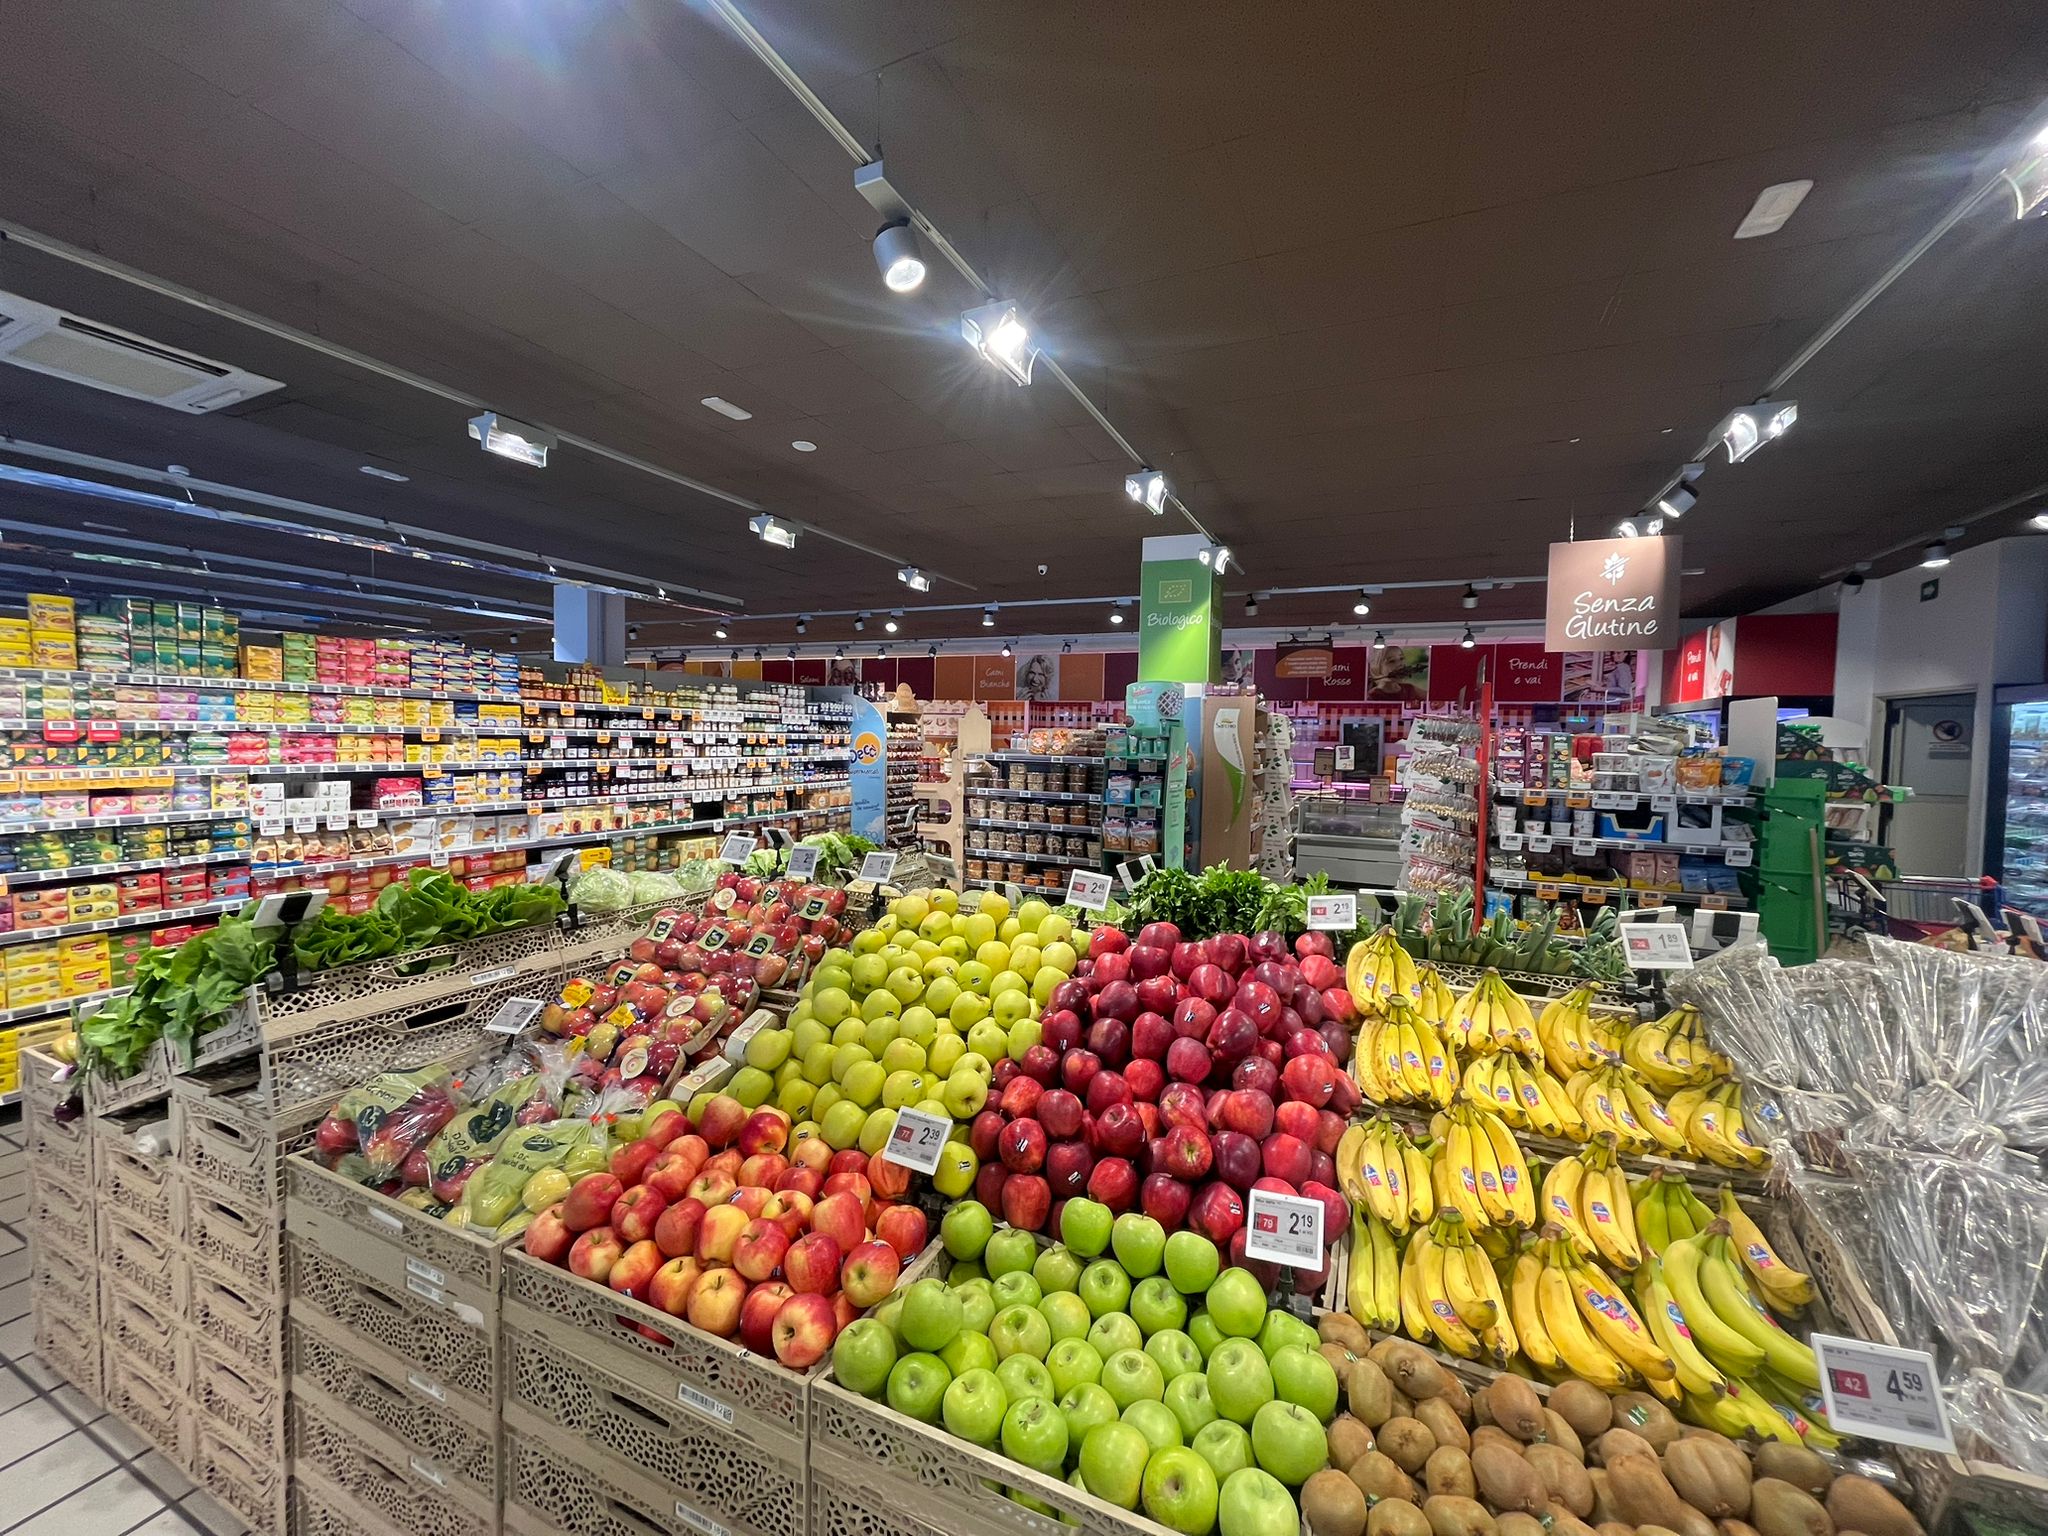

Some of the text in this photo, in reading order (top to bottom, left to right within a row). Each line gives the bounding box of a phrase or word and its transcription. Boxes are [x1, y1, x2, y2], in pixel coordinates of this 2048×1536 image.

[1573, 590, 1657, 615] Senza
[1147, 612, 1203, 631] Biologico
[1565, 615, 1659, 641] Glutine
[1509, 658, 1548, 670] Prendi
[1322, 676, 1352, 687] Rosse
[1514, 675, 1542, 685] e vai
[1658, 934, 1678, 949] 189
[918, 1126, 941, 1146] 239
[1263, 1217, 1274, 1229] 79
[1288, 1212, 1313, 1236] 219
[1844, 1369, 1923, 1402] 42 459
